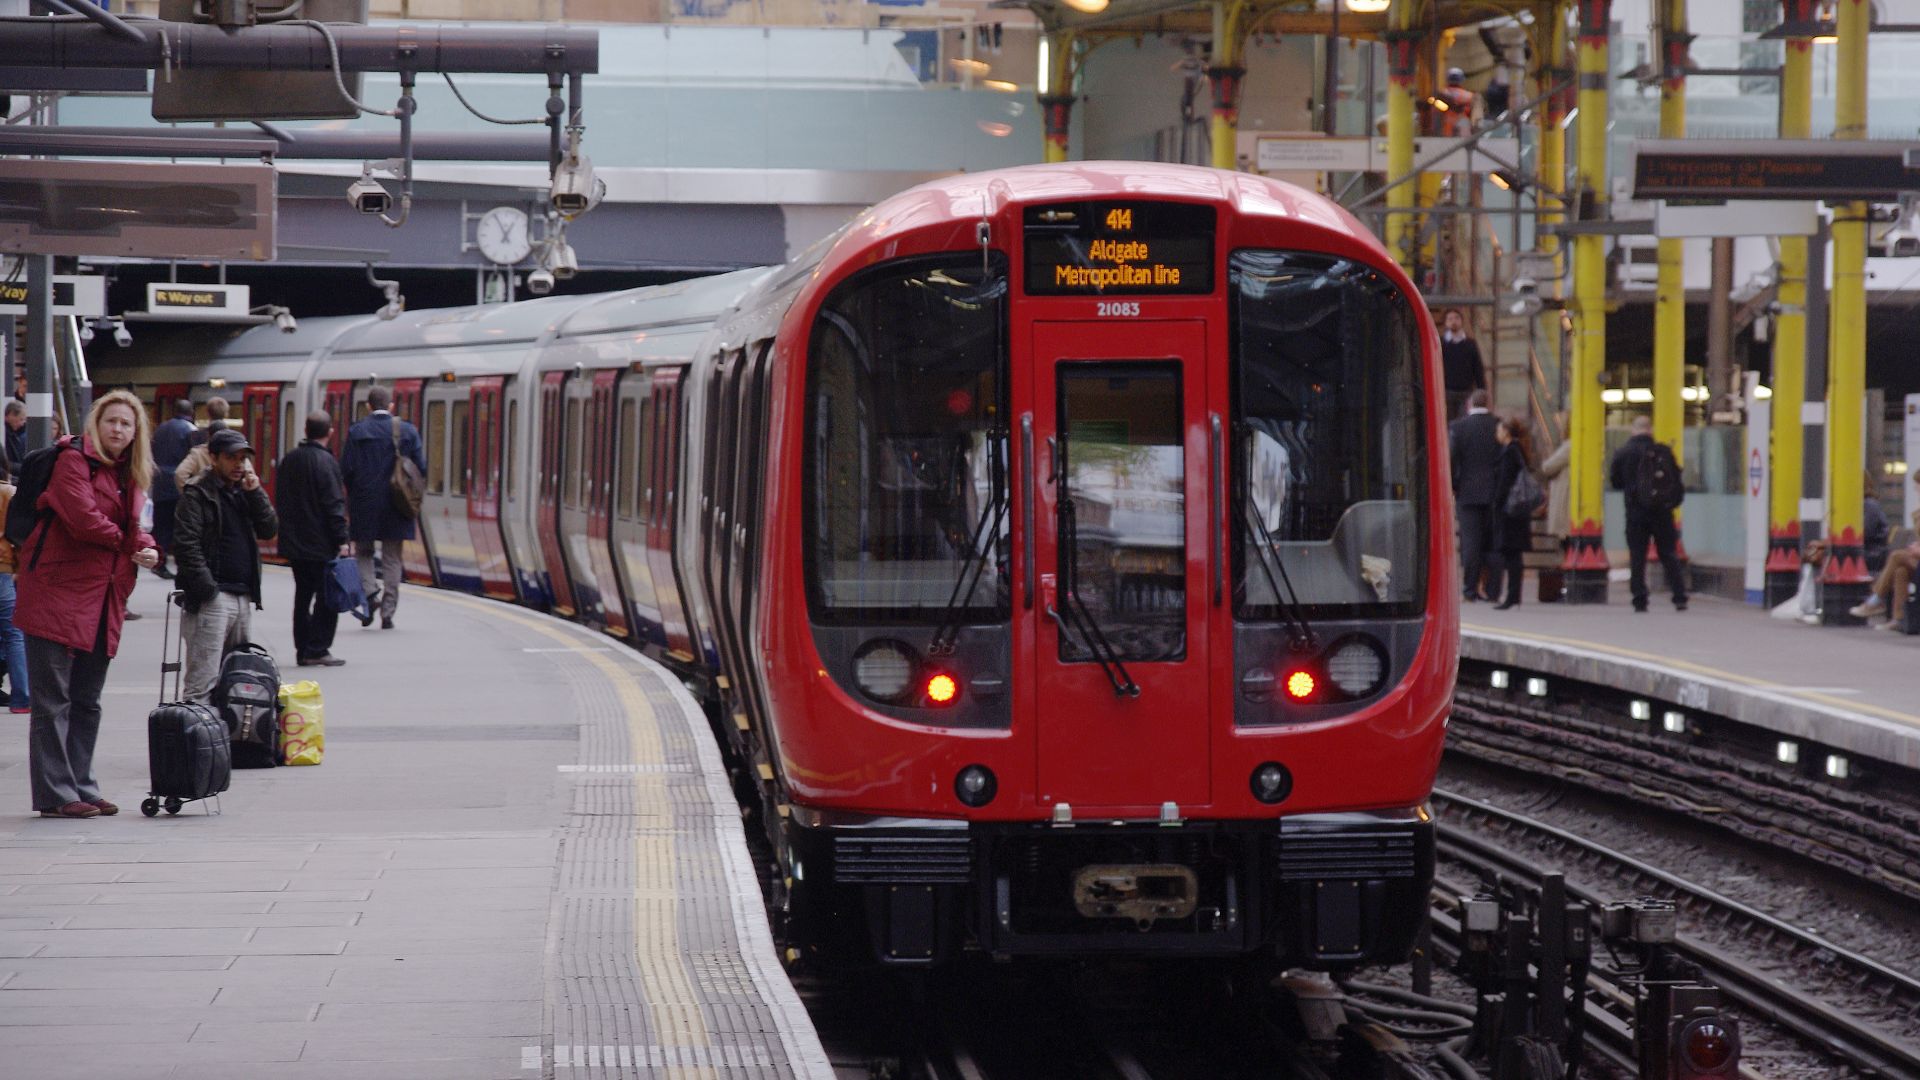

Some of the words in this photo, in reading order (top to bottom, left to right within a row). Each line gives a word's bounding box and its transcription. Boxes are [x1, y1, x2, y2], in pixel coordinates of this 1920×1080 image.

[1106, 208, 1133, 231] 414
[1088, 239, 1149, 264] Aldgate
[1055, 264, 1151, 290] Metropolitan
[1154, 264, 1180, 285] line
[168, 291, 192, 305] Way
[193, 294, 214, 304] out
[1097, 302, 1140, 316] 21083
